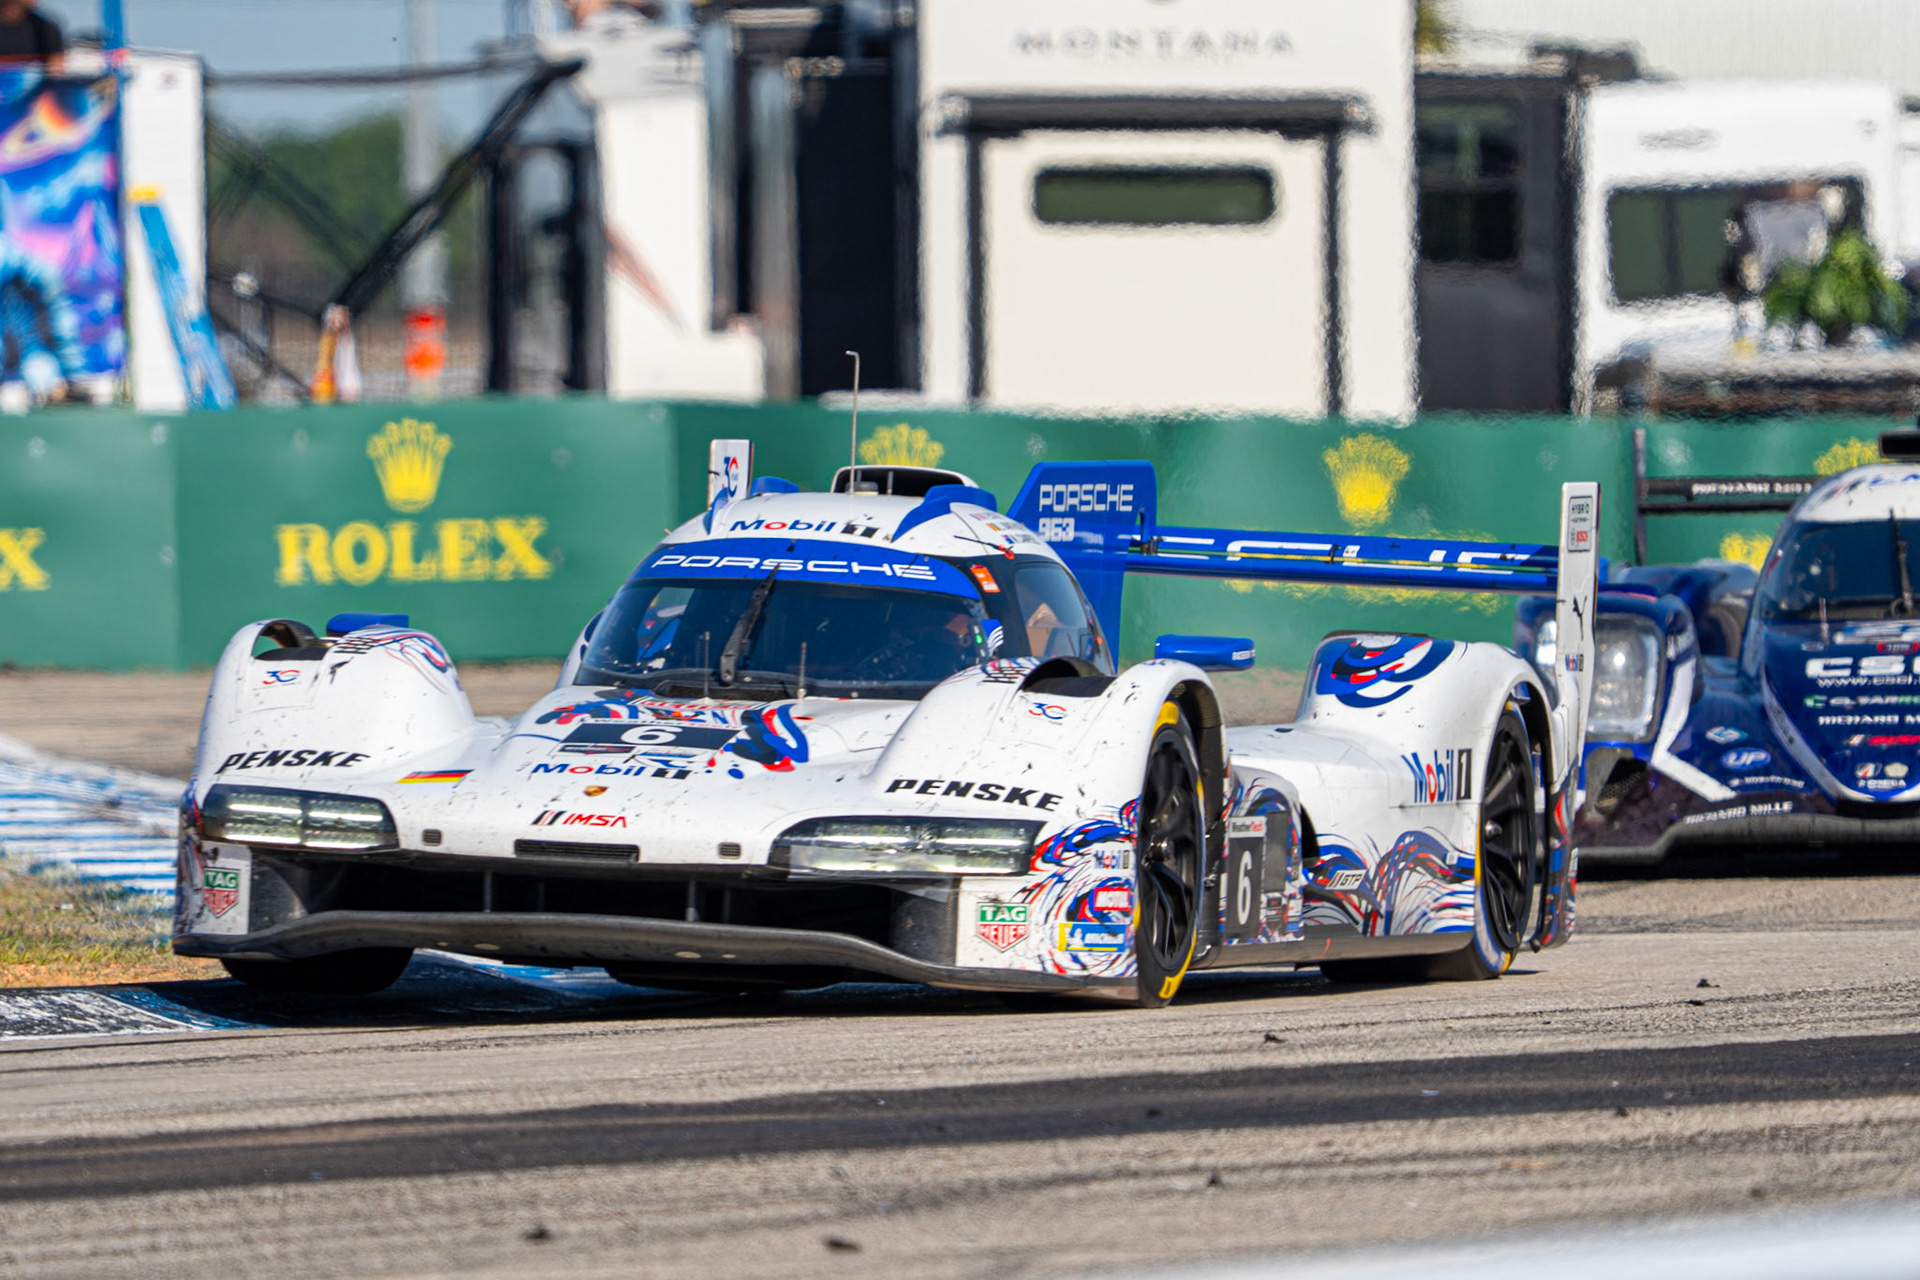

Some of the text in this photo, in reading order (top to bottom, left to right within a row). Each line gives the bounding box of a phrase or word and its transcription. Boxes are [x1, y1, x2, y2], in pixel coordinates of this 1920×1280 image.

[1010, 27, 1298, 57] MONTANA
[1038, 484, 1134, 511] PORSCHE
[729, 519, 836, 533] Mobil
[1038, 517, 1075, 541] 963
[275, 516, 553, 586] ROLEX
[651, 555, 937, 581] PORSCHE
[620, 725, 683, 745] 6
[214, 750, 371, 774] PENSKE
[532, 763, 646, 776] Mobil
[1727, 751, 1767, 766] UP
[1400, 749, 1454, 804] Mobil
[885, 779, 1064, 812] PENSKE
[1749, 801, 1793, 816] MILLE
[562, 814, 628, 828] IMSA
[206, 871, 237, 888] TAG
[1237, 849, 1253, 926] 6
[1340, 873, 1363, 886] GTP
[980, 906, 1026, 921] TAG
[978, 924, 1028, 947] HEUER
